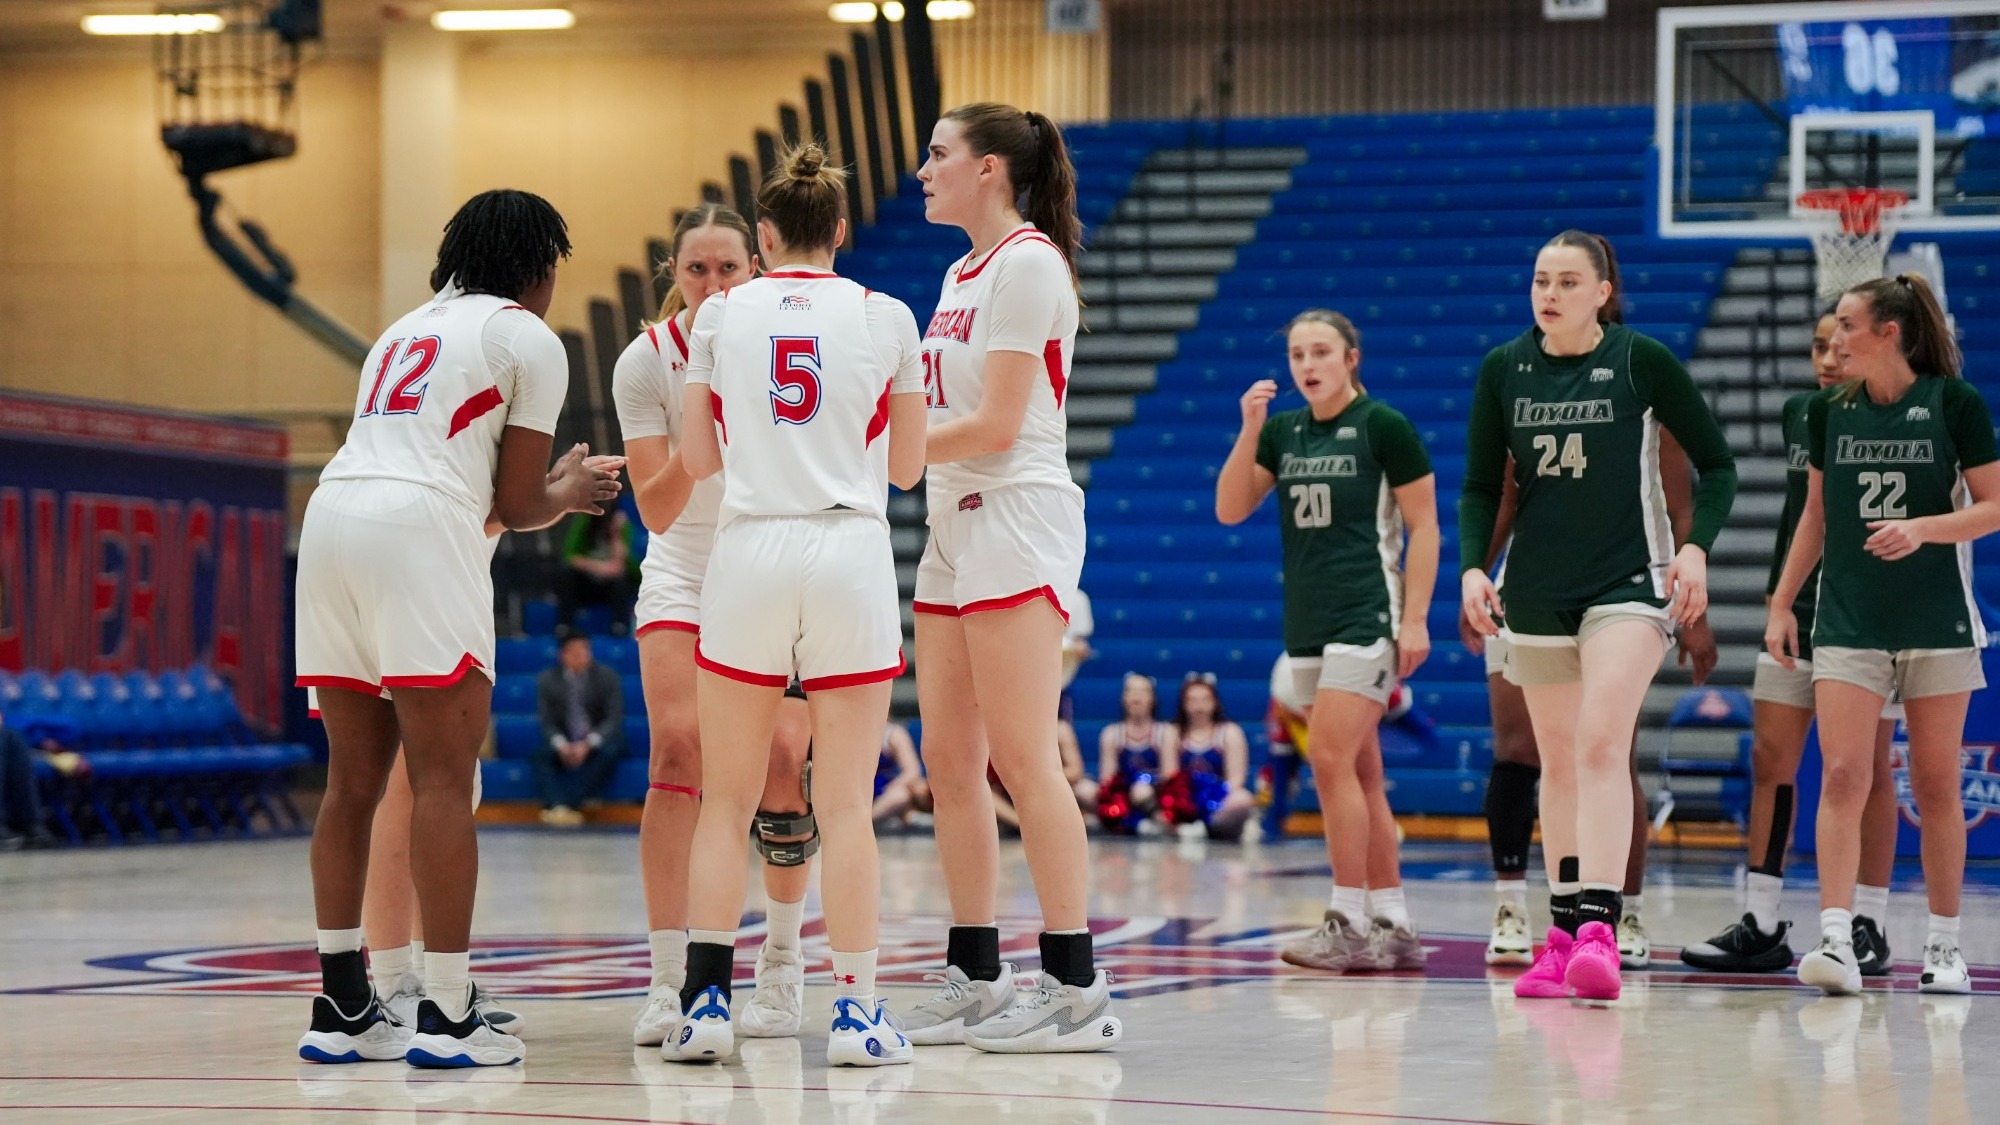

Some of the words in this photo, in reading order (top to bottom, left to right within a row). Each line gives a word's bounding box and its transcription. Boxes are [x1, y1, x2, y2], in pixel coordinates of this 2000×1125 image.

[359, 335, 442, 418] 12
[769, 336, 822, 425] 5
[921, 349, 949, 409] 21
[1514, 398, 1614, 427] LOYOLA
[1533, 433, 1587, 479] 24
[1835, 434, 1934, 464] LOYOLA
[1289, 483, 1332, 529] 20
[1858, 471, 1908, 519] 22
